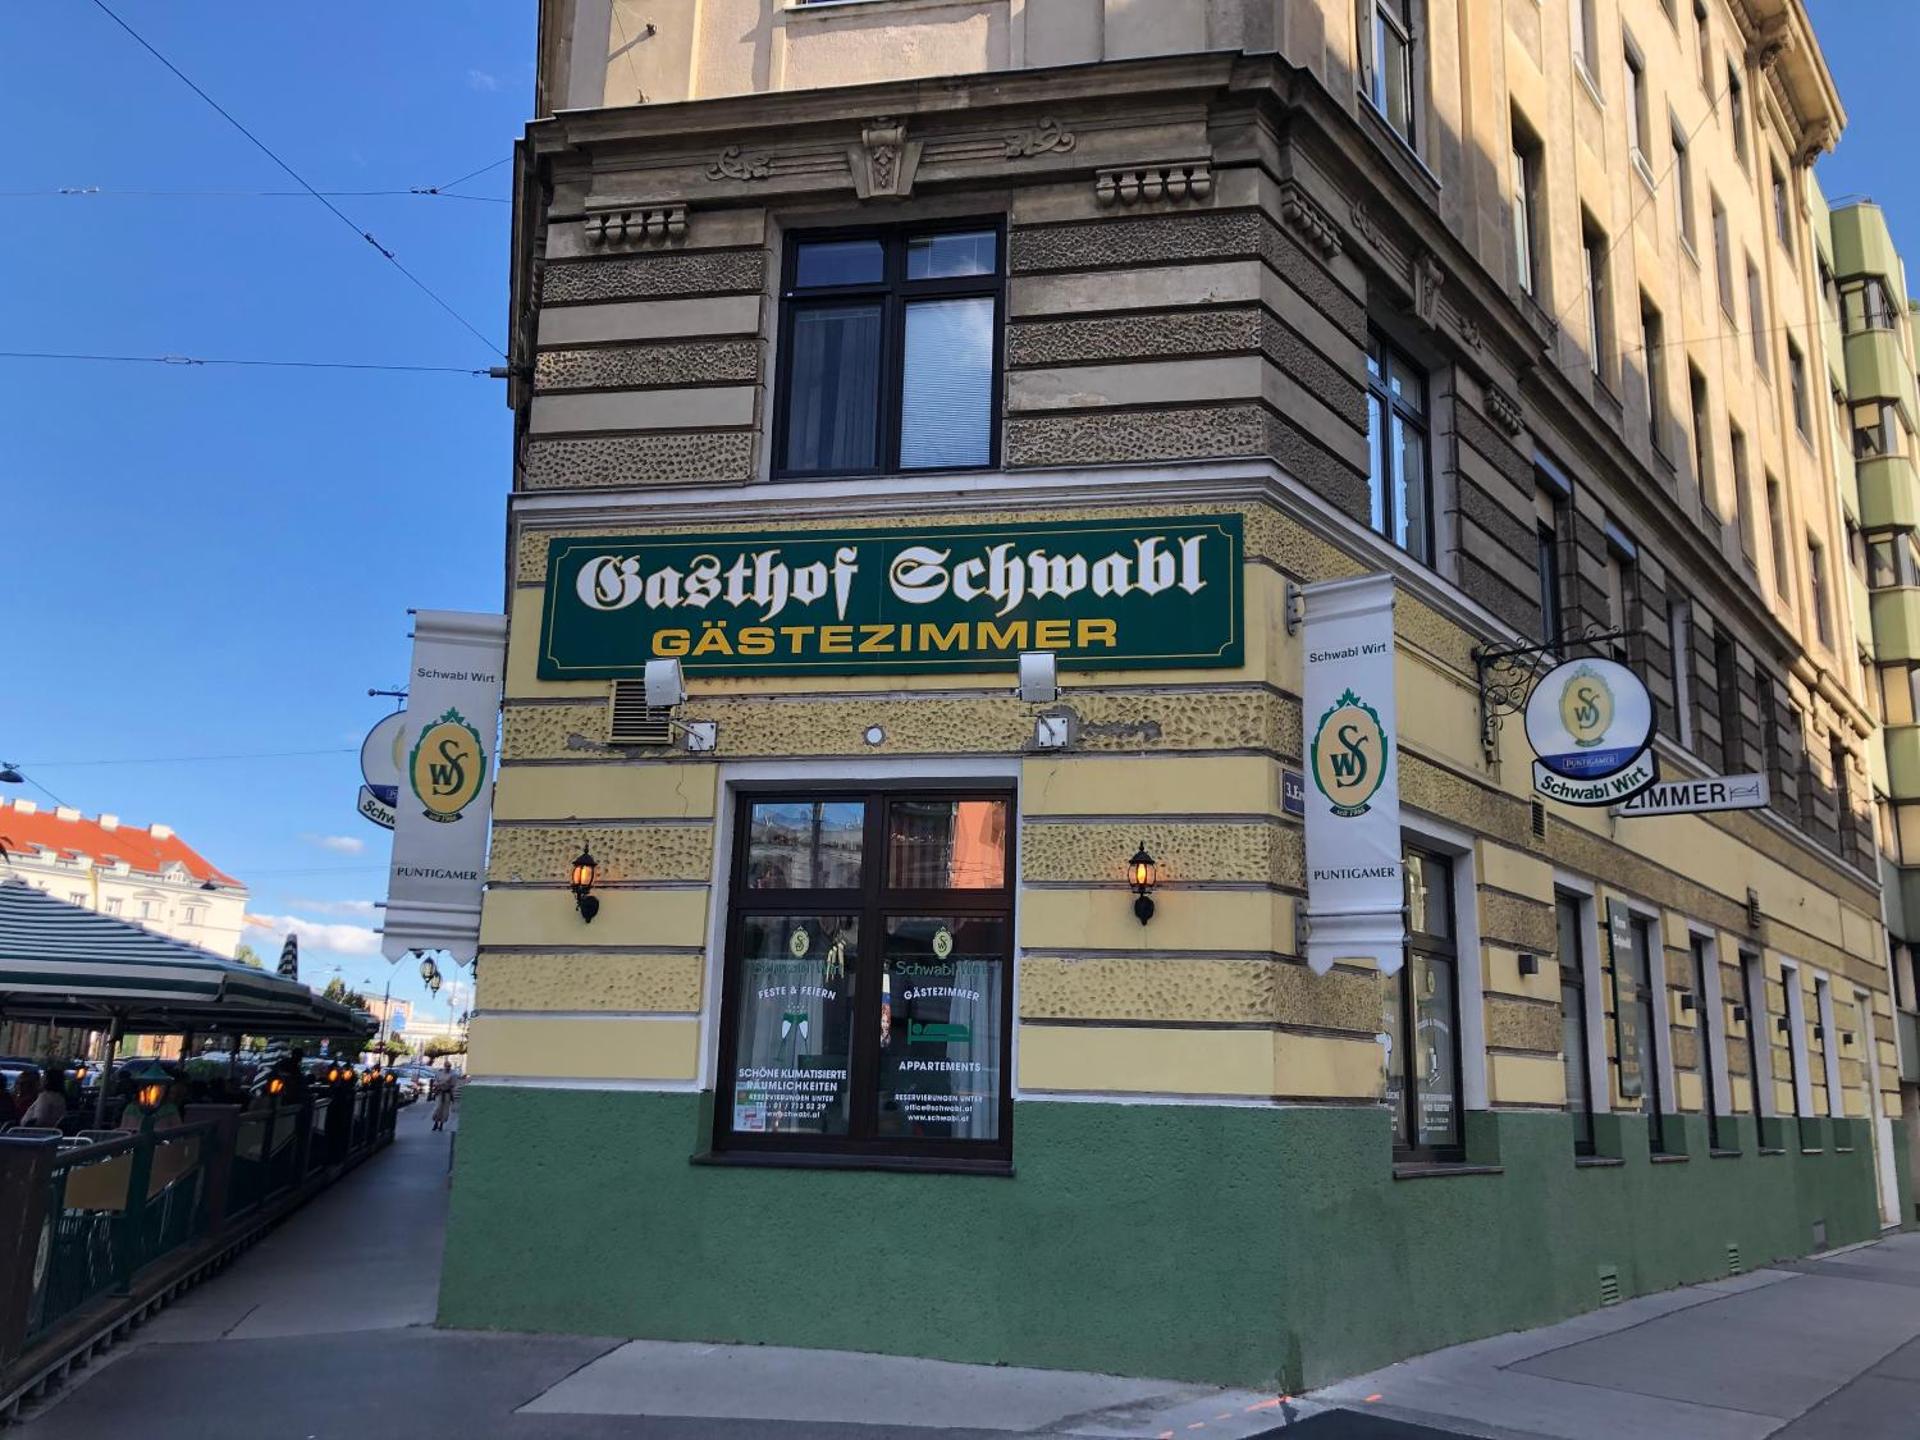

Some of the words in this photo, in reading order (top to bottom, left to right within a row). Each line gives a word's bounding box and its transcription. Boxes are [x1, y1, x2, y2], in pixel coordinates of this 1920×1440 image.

[575, 546, 859, 623] Gasthof
[889, 534, 1208, 618] Schwabl
[651, 618, 1118, 657] GÄSTEZIMMER
[1309, 646, 1359, 663] Schwabl
[1361, 642, 1387, 655] Wirt
[416, 667, 468, 681] Schwabl
[471, 671, 496, 683] Wirt
[1540, 774, 1610, 799] Schwabl
[1610, 766, 1649, 793] Wirt
[396, 866, 479, 881] PUNTIGAMER
[1313, 866, 1396, 880] PUNTIGAMER
[895, 960, 955, 977] Schwabl
[758, 985, 787, 999] FESTE
[790, 985, 797, 994] &
[800, 985, 837, 1001] FEIERN
[903, 985, 980, 1002] GÄSTEZIMMER
[739, 1066, 779, 1078] SCHÖNE
[898, 1060, 982, 1073] APPARTEMENTS
[746, 1079, 838, 1092] RÄUMLICHKEITEN
